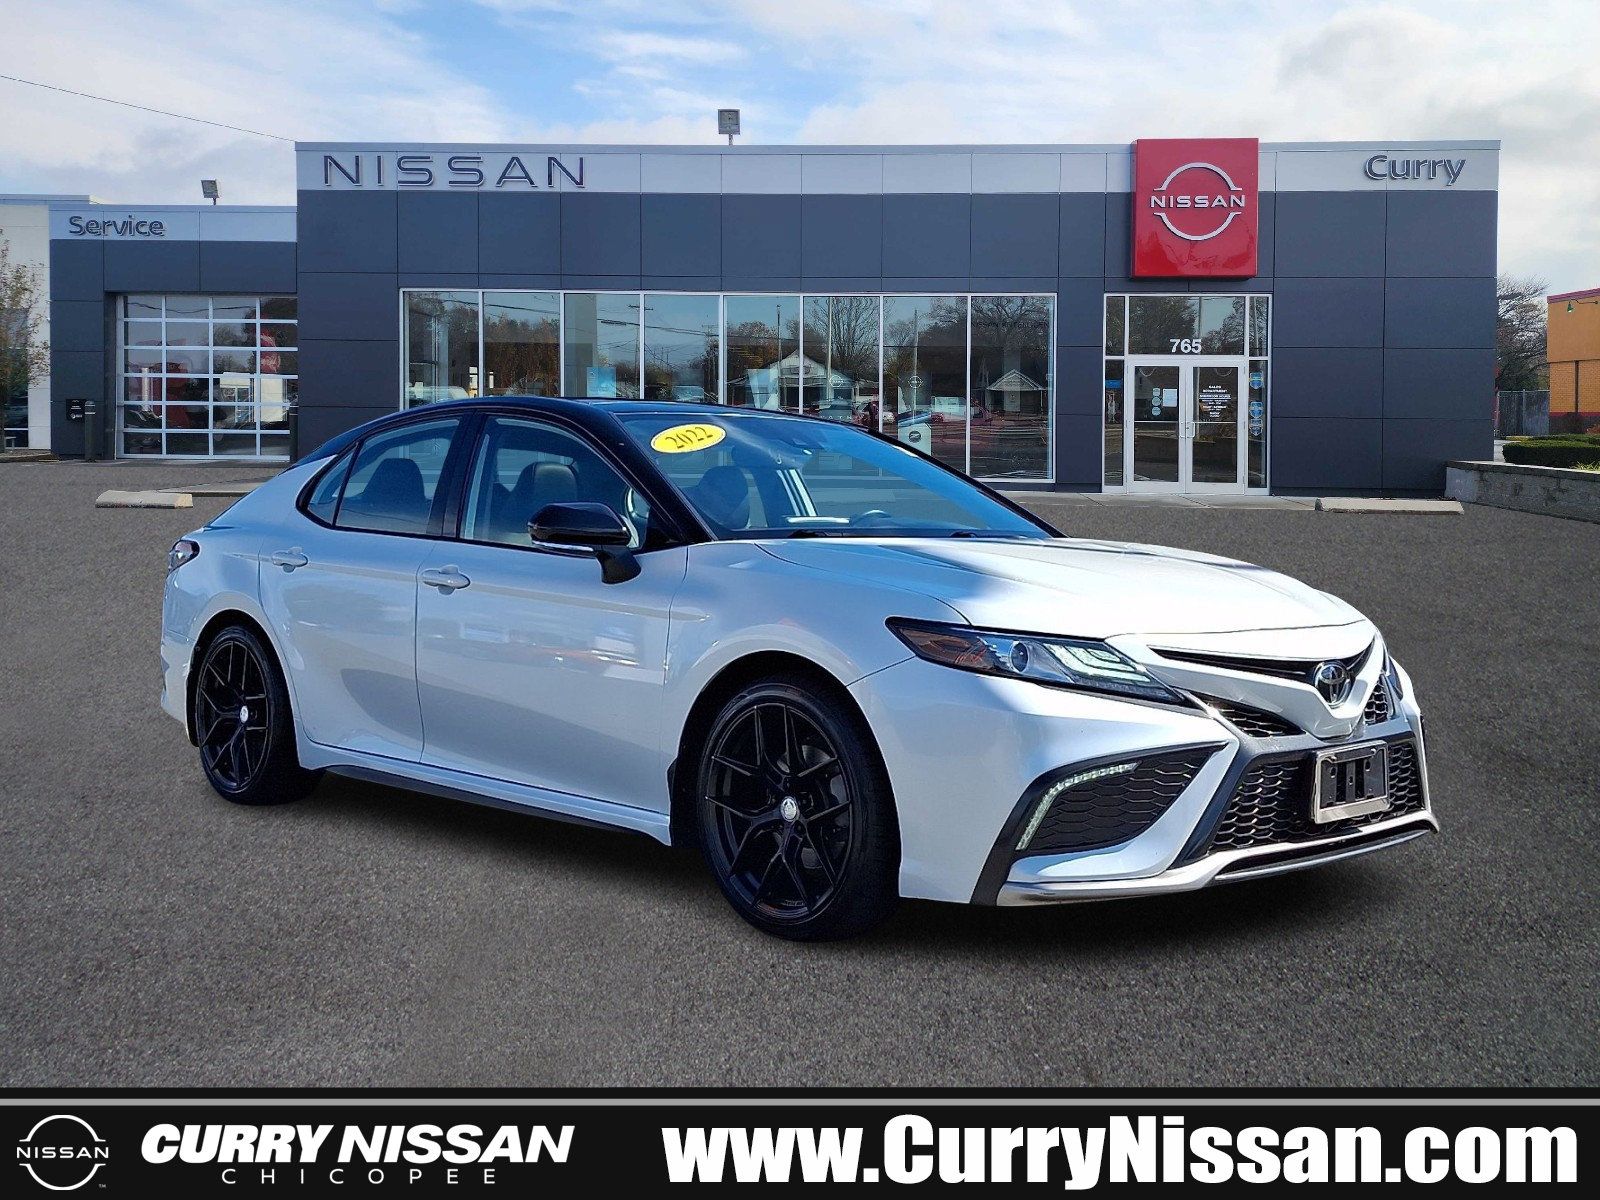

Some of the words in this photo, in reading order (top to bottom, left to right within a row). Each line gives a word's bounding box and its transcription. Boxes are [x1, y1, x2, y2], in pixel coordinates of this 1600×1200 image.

[323, 155, 585, 188] NISSAN
[1363, 154, 1467, 187] Curry
[1149, 194, 1246, 209] NISSAN
[68, 214, 166, 237] Service
[1169, 338, 1202, 354] 765
[664, 426, 714, 449] 2022
